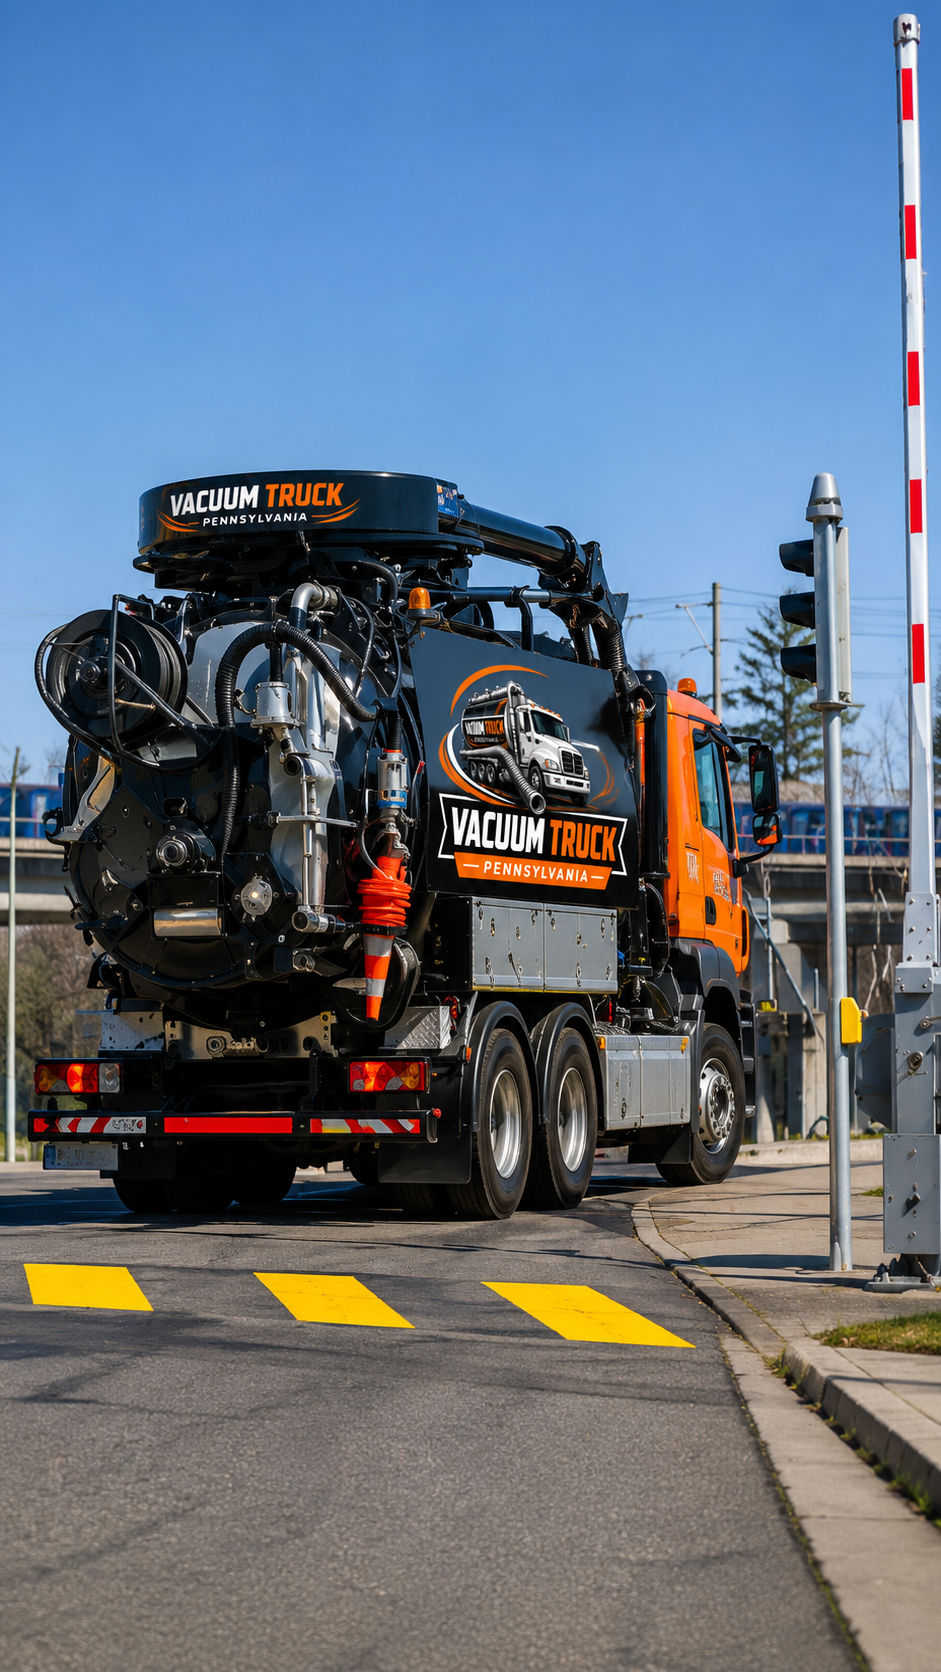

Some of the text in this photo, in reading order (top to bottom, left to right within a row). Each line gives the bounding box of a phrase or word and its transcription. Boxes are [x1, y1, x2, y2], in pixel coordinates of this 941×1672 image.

[170, 482, 344, 517] VACUUM TRUCK
[202, 512, 307, 527] PENNSYLVANIA
[451, 806, 618, 862] VACUUM TRUCK
[483, 861, 588, 883] PENNSYLVANIA
